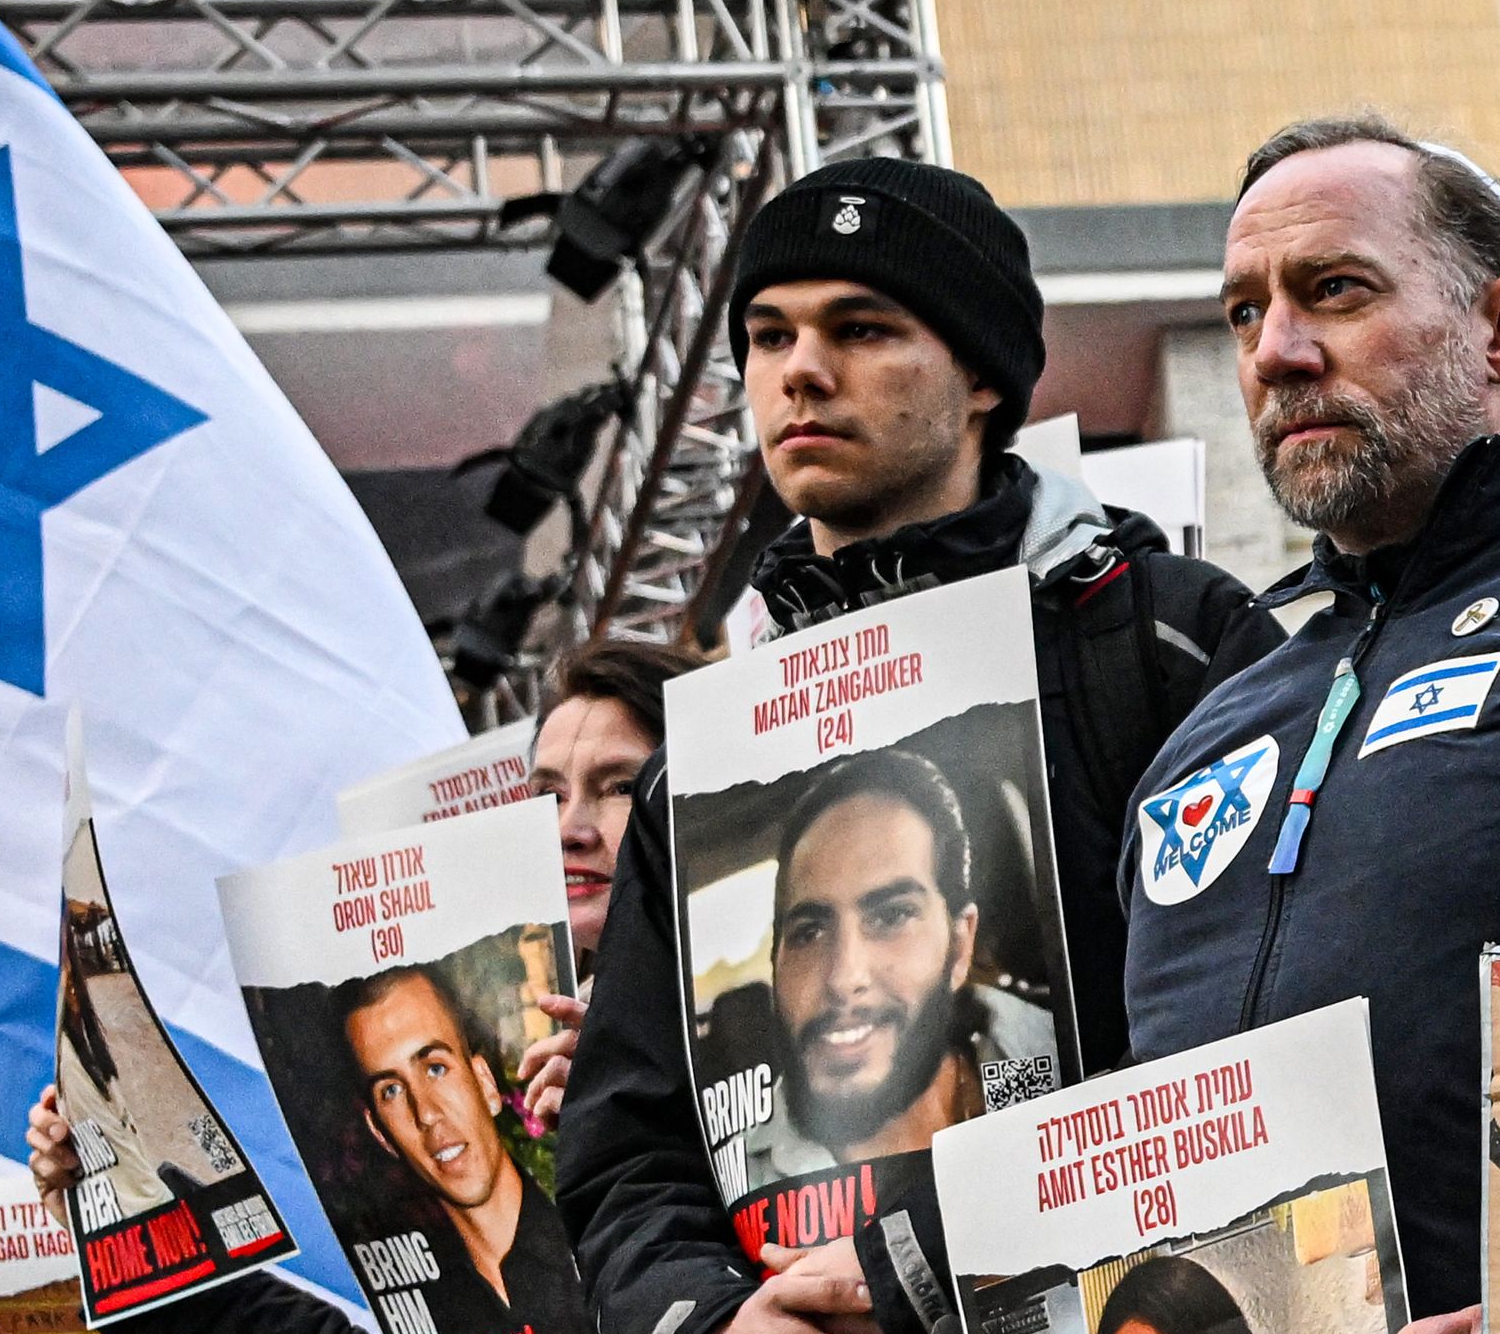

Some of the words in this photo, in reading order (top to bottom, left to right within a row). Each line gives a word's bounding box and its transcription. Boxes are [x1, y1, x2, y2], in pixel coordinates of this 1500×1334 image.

[855, 624, 890, 666] מתן
[754, 687, 810, 735] MATAN
[815, 652, 923, 713] ZANGAUKER
[818, 708, 853, 754] (24)
[381, 844, 426, 886] אורון
[1153, 808, 1252, 882] WELCOME
[331, 857, 377, 895] שאול
[333, 894, 377, 932] ORON
[379, 880, 436, 921] SHAUL
[371, 923, 404, 963] (30)
[703, 1063, 772, 1146] BRING
[1127, 1078, 1190, 1132] אסתר
[1195, 1059, 1252, 1114] עמית
[1037, 1099, 1125, 1162] בוסקילה
[1038, 1160, 1085, 1213] AMIT
[1091, 1135, 1171, 1195] ESTHER
[1173, 1105, 1268, 1170] BUSKILA
[77, 1172, 122, 1235] HER
[777, 1164, 876, 1247] NOW!
[1134, 1180, 1176, 1236] (28)
[86, 1224, 152, 1292] HOME
[353, 1231, 440, 1291] BRING
